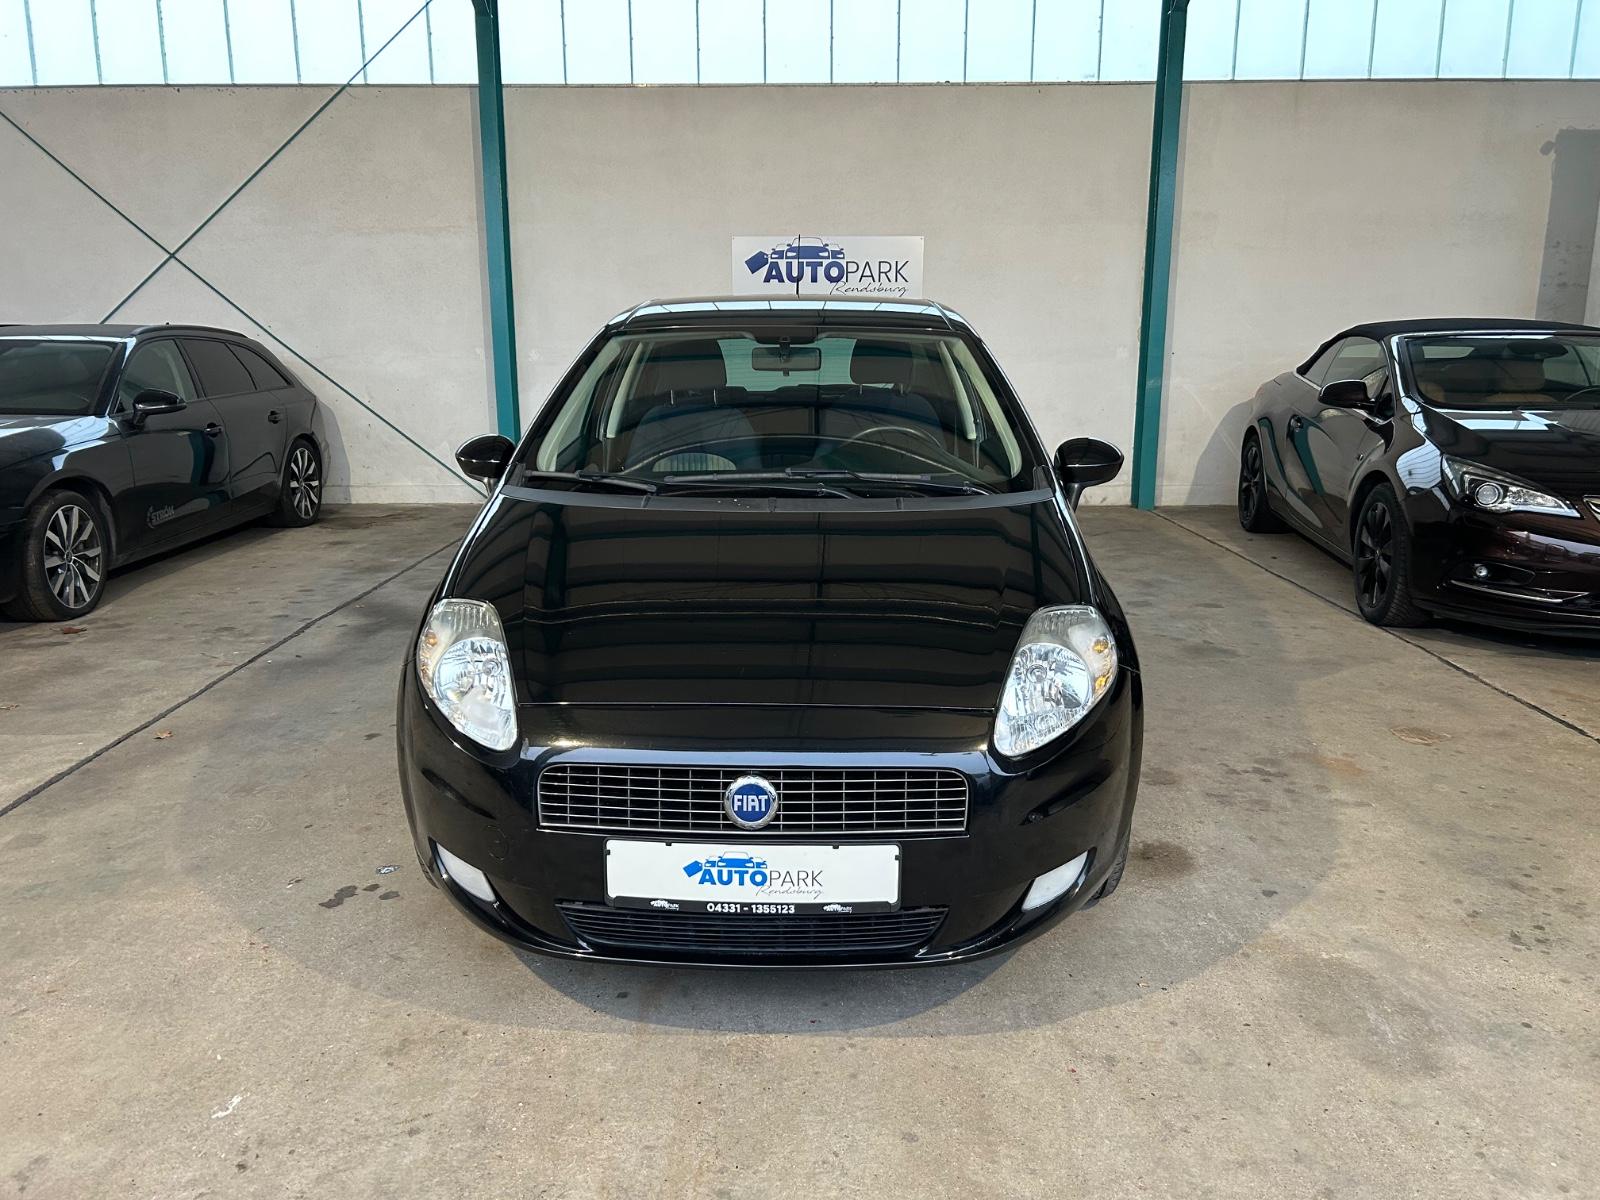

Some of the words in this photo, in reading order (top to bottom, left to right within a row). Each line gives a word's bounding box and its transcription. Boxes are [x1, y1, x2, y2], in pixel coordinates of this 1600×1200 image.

[830, 281, 907, 297] Rendsburg
[733, 794, 768, 811] FIAT
[706, 902, 741, 913] 04331
[751, 904, 795, 914] 1355123
